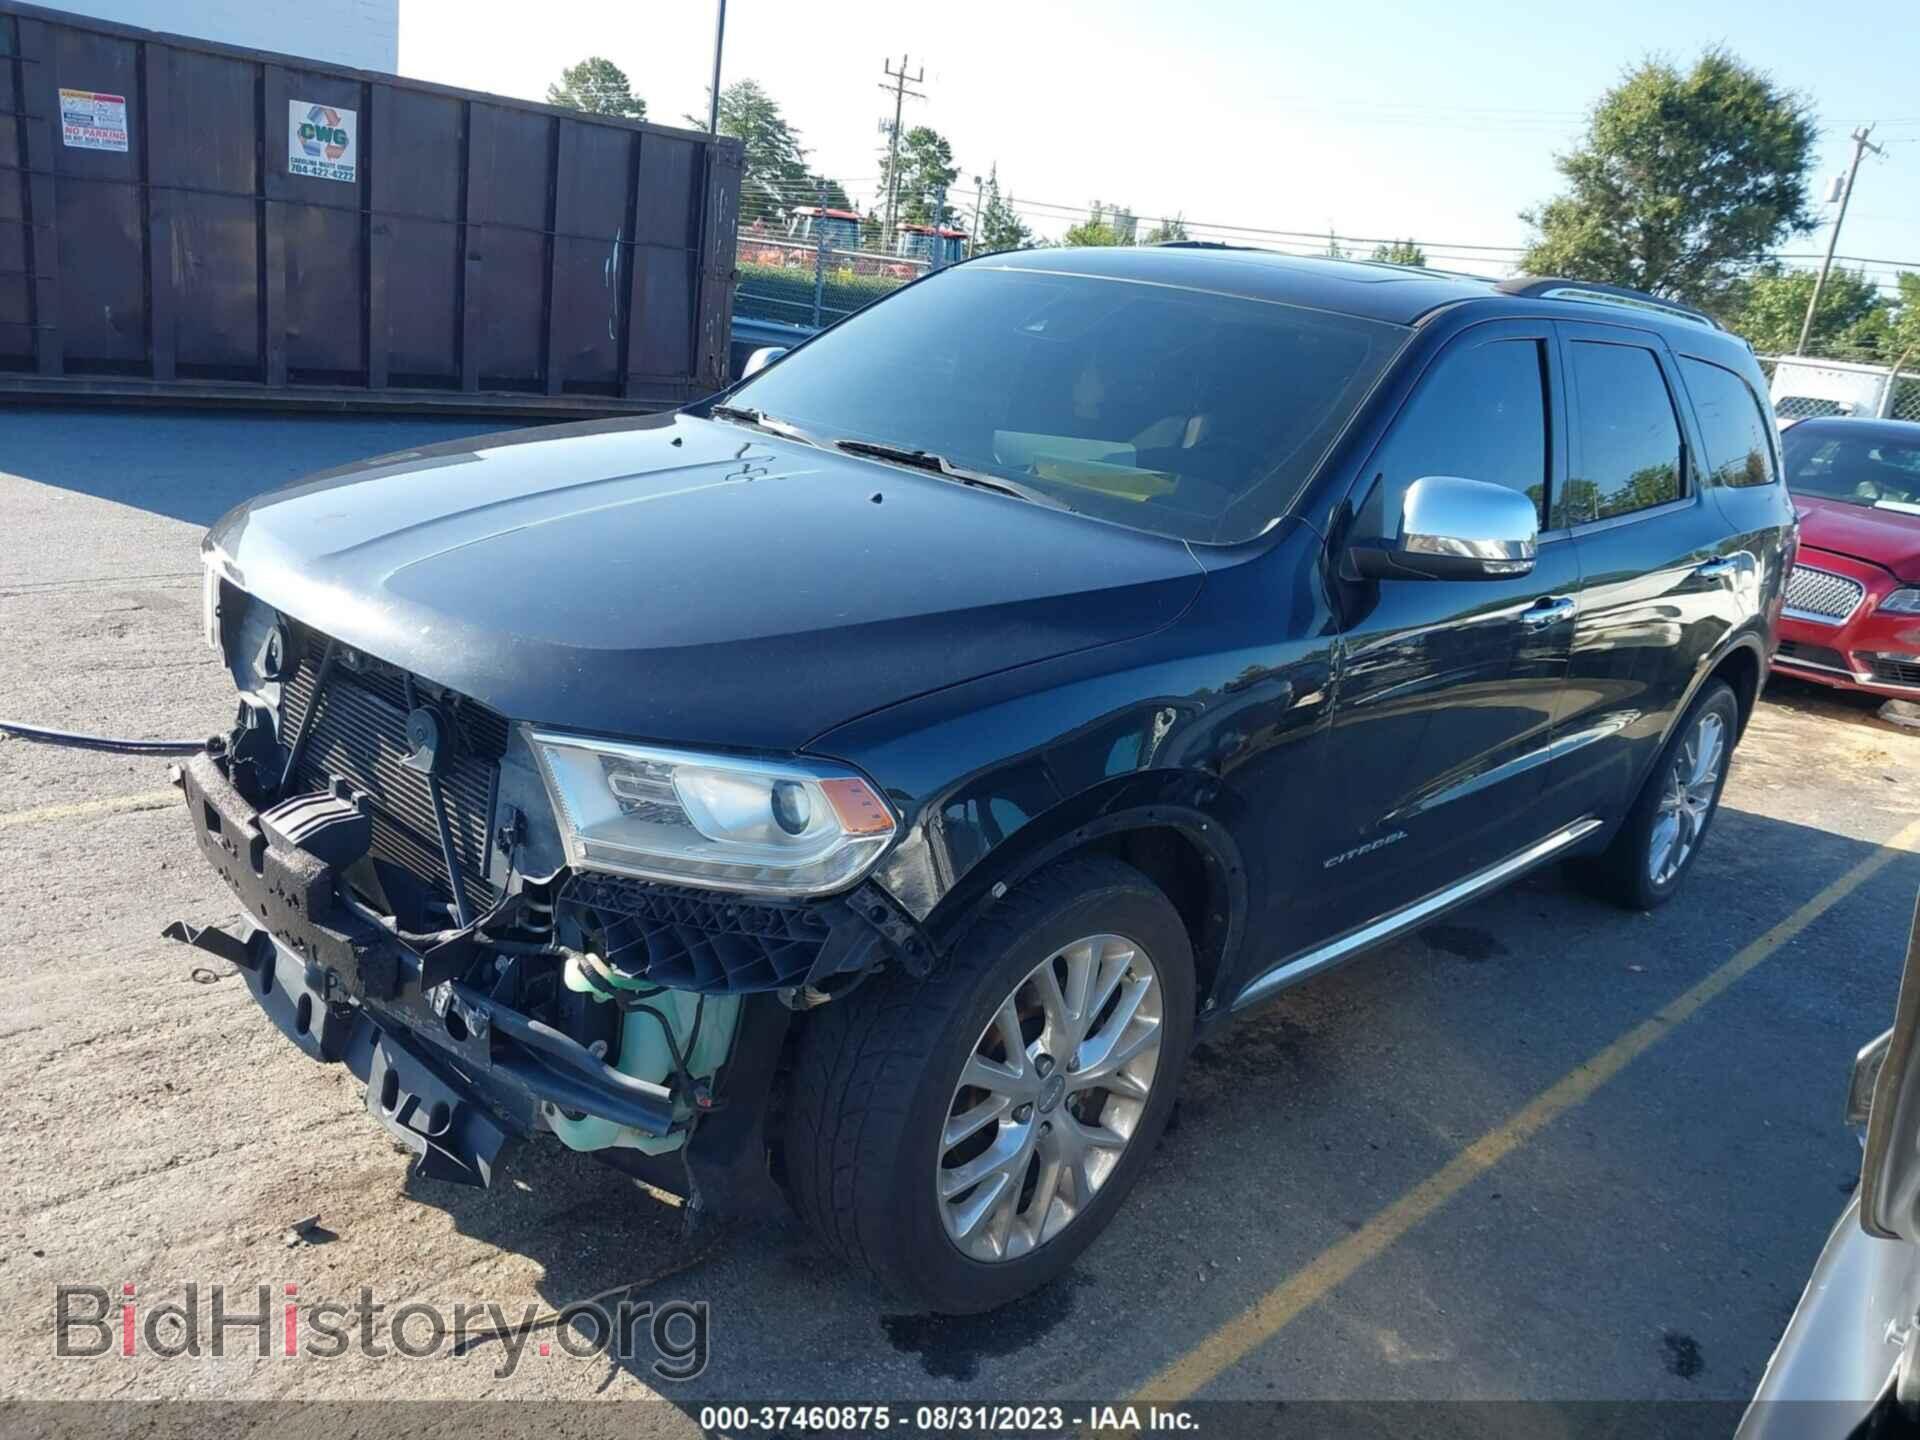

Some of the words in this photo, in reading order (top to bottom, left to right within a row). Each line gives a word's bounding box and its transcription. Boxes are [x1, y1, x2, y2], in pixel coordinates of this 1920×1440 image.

[65, 127, 79, 135] NO
[83, 128, 126, 140] PARKING
[300, 123, 347, 145] CWG
[1323, 831, 1408, 868] CITADEL
